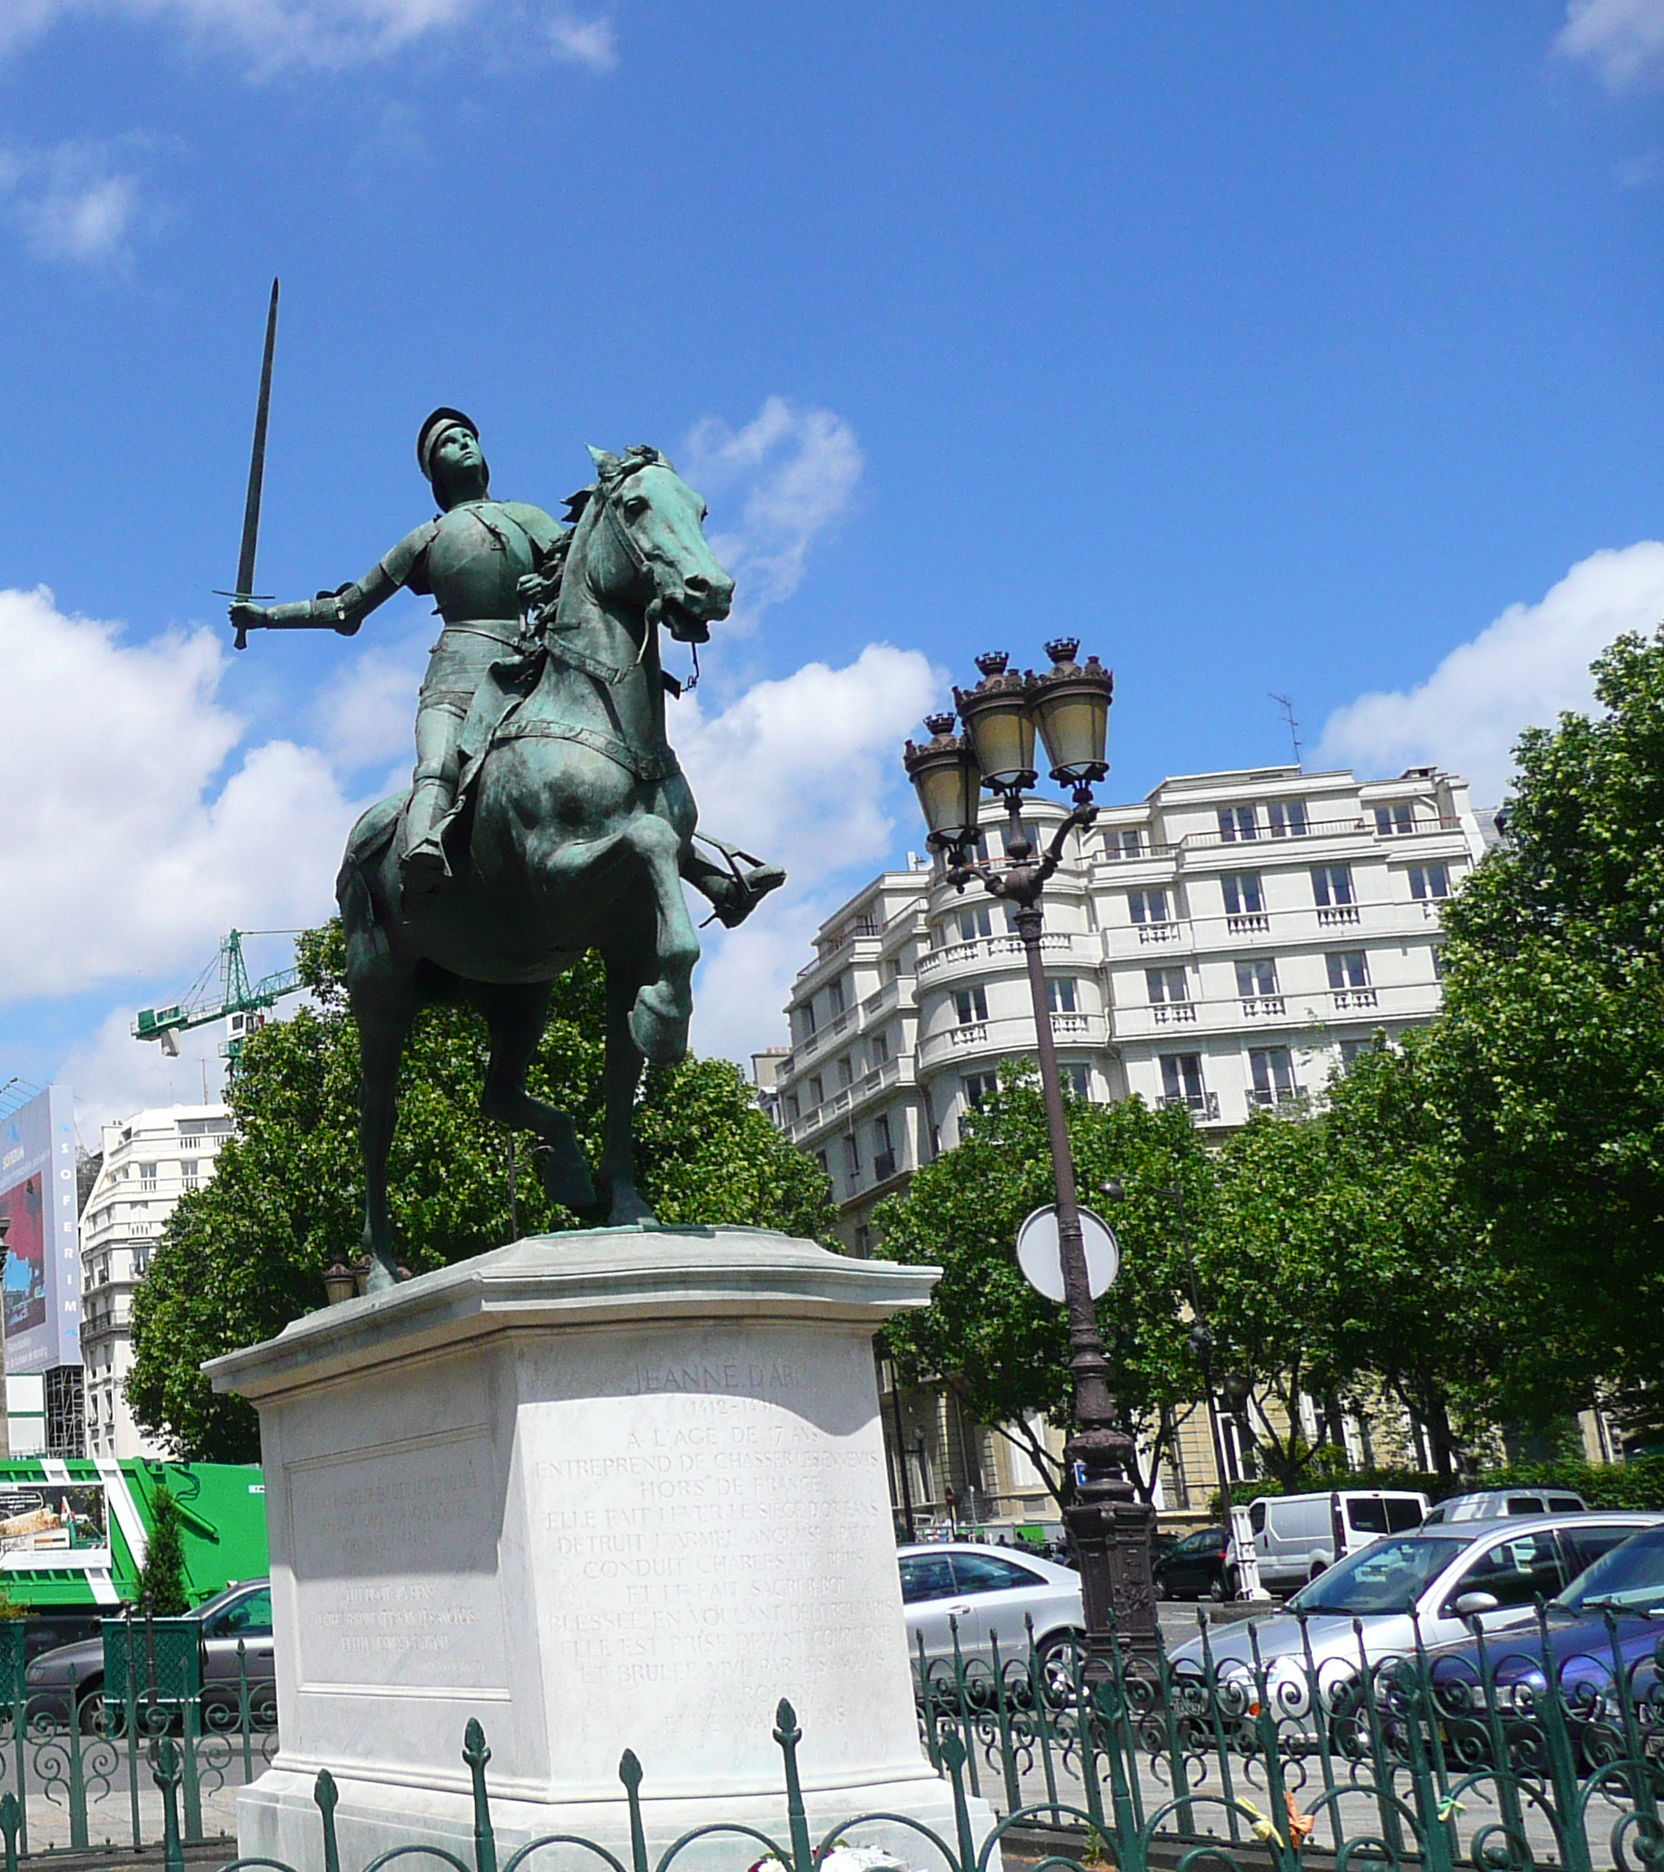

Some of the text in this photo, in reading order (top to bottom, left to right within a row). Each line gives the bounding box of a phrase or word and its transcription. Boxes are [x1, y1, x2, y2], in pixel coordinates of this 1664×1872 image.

[59, 1142, 78, 1312] SOFERIM
[630, 1364, 737, 1395] JEANNE
[627, 1433, 643, 1450] A
[732, 1426, 758, 1444] DE
[792, 1426, 819, 1444] ANS
[535, 1455, 673, 1477] ENTREPREND
[680, 1453, 707, 1473] DE
[713, 1450, 793, 1471] CHASSER
[796, 1451, 820, 1468] LES
[641, 1480, 704, 1500] HORS
[716, 1477, 744, 1496] DE
[547, 1510, 596, 1531] ELLE
[605, 1507, 650, 1528] FAIT
[583, 1556, 686, 1580] CONDUIT
[696, 1552, 785, 1575] CHARLES
[653, 1609, 681, 1629] EN
[688, 1603, 780, 1627] VOULANT
[561, 1638, 612, 1659] ELLE
[620, 1636, 660, 1656] EST
[671, 1633, 728, 1653] PRISE
[581, 1664, 609, 1684] ET
[760, 1657, 792, 1674] PAR
